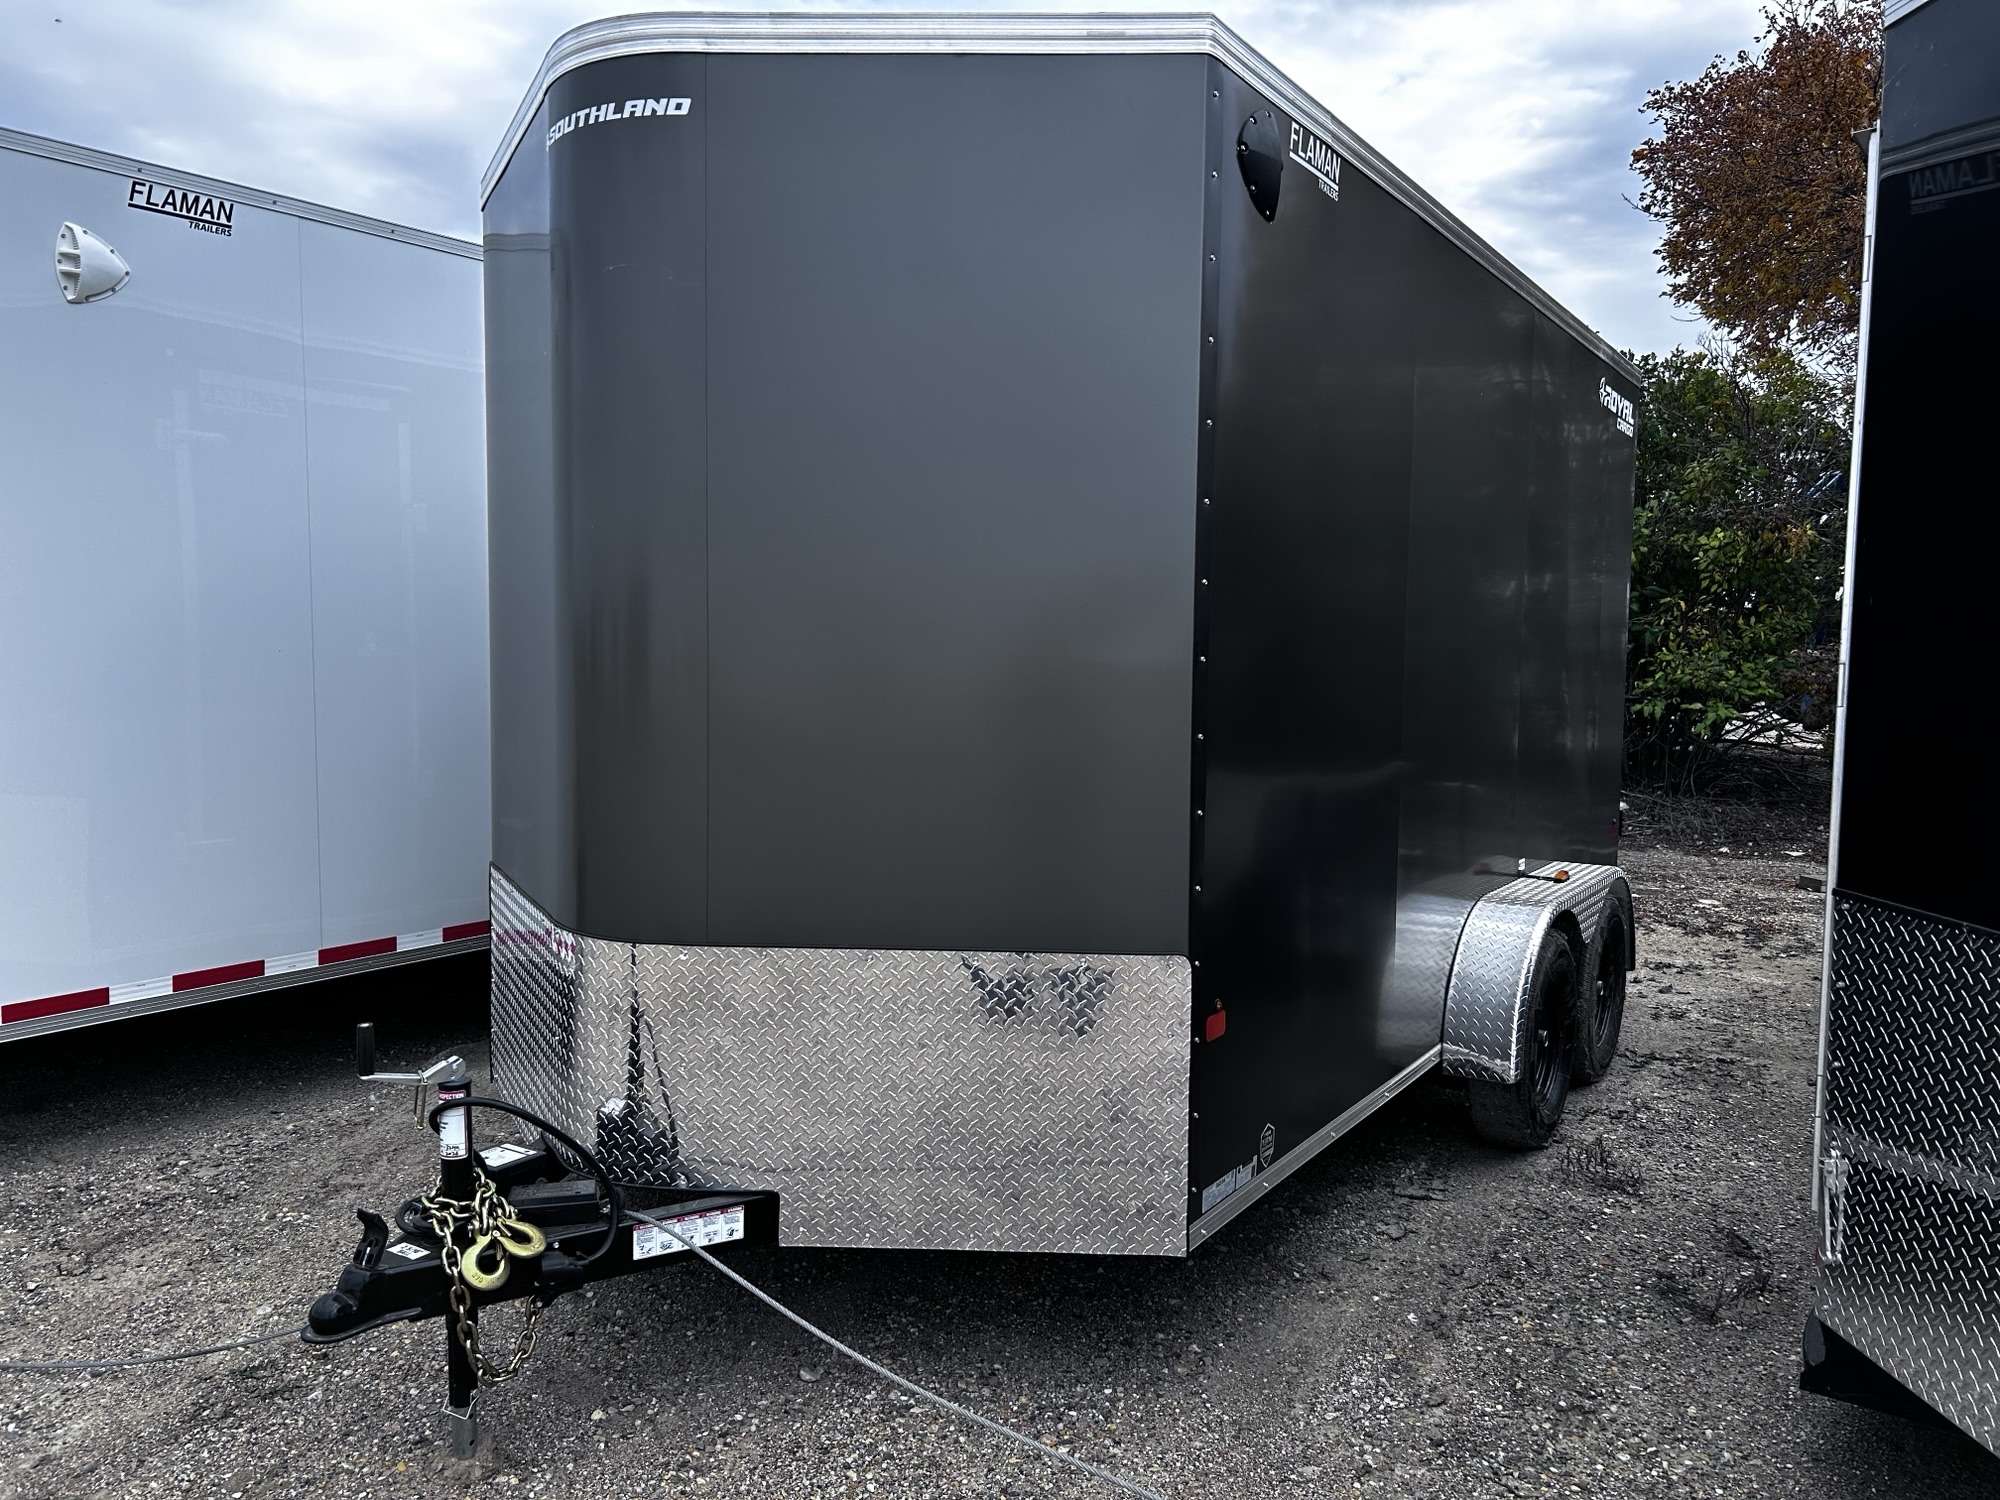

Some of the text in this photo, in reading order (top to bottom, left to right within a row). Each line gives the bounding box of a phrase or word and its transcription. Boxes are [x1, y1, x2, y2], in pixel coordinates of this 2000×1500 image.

[547, 98, 692, 147] SOUTHLAND
[1290, 121, 1340, 184] FLAMAN
[129, 180, 234, 223] FLAMAN
[1318, 179, 1339, 202] TRAILERS
[189, 221, 232, 237] TRAILERS
[1604, 385, 1634, 425] ROYAL
